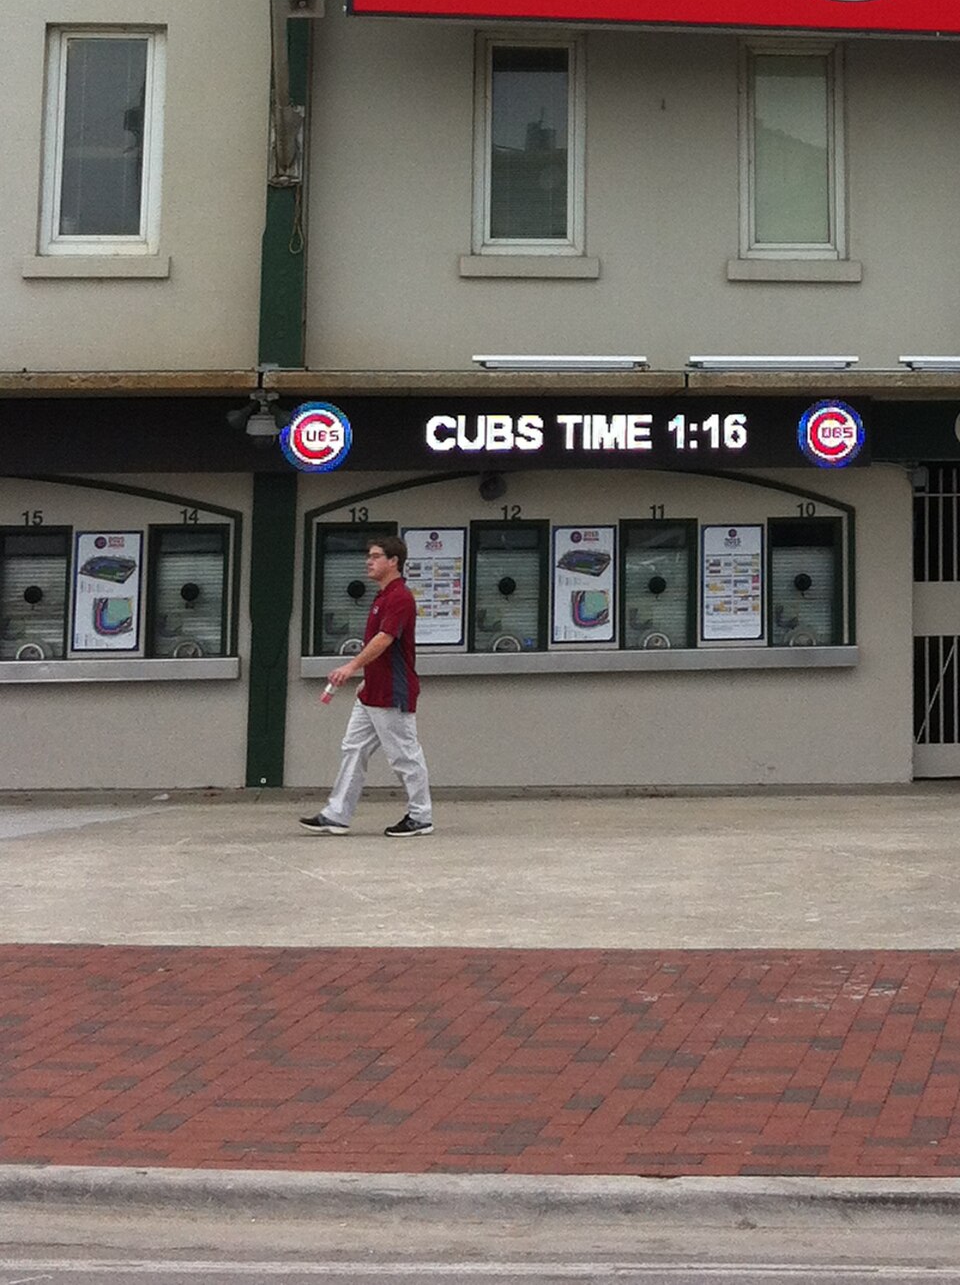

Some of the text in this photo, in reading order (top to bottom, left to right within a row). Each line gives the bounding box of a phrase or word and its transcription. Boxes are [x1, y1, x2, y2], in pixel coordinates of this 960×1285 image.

[425, 414, 747, 452] CUBS TIME 1:16
[180, 509, 200, 525] 14
[349, 508, 369, 523] 13
[501, 505, 521, 520] 12
[650, 504, 665, 519] 11
[797, 503, 815, 518] 10
[22, 511, 43, 526] 15
